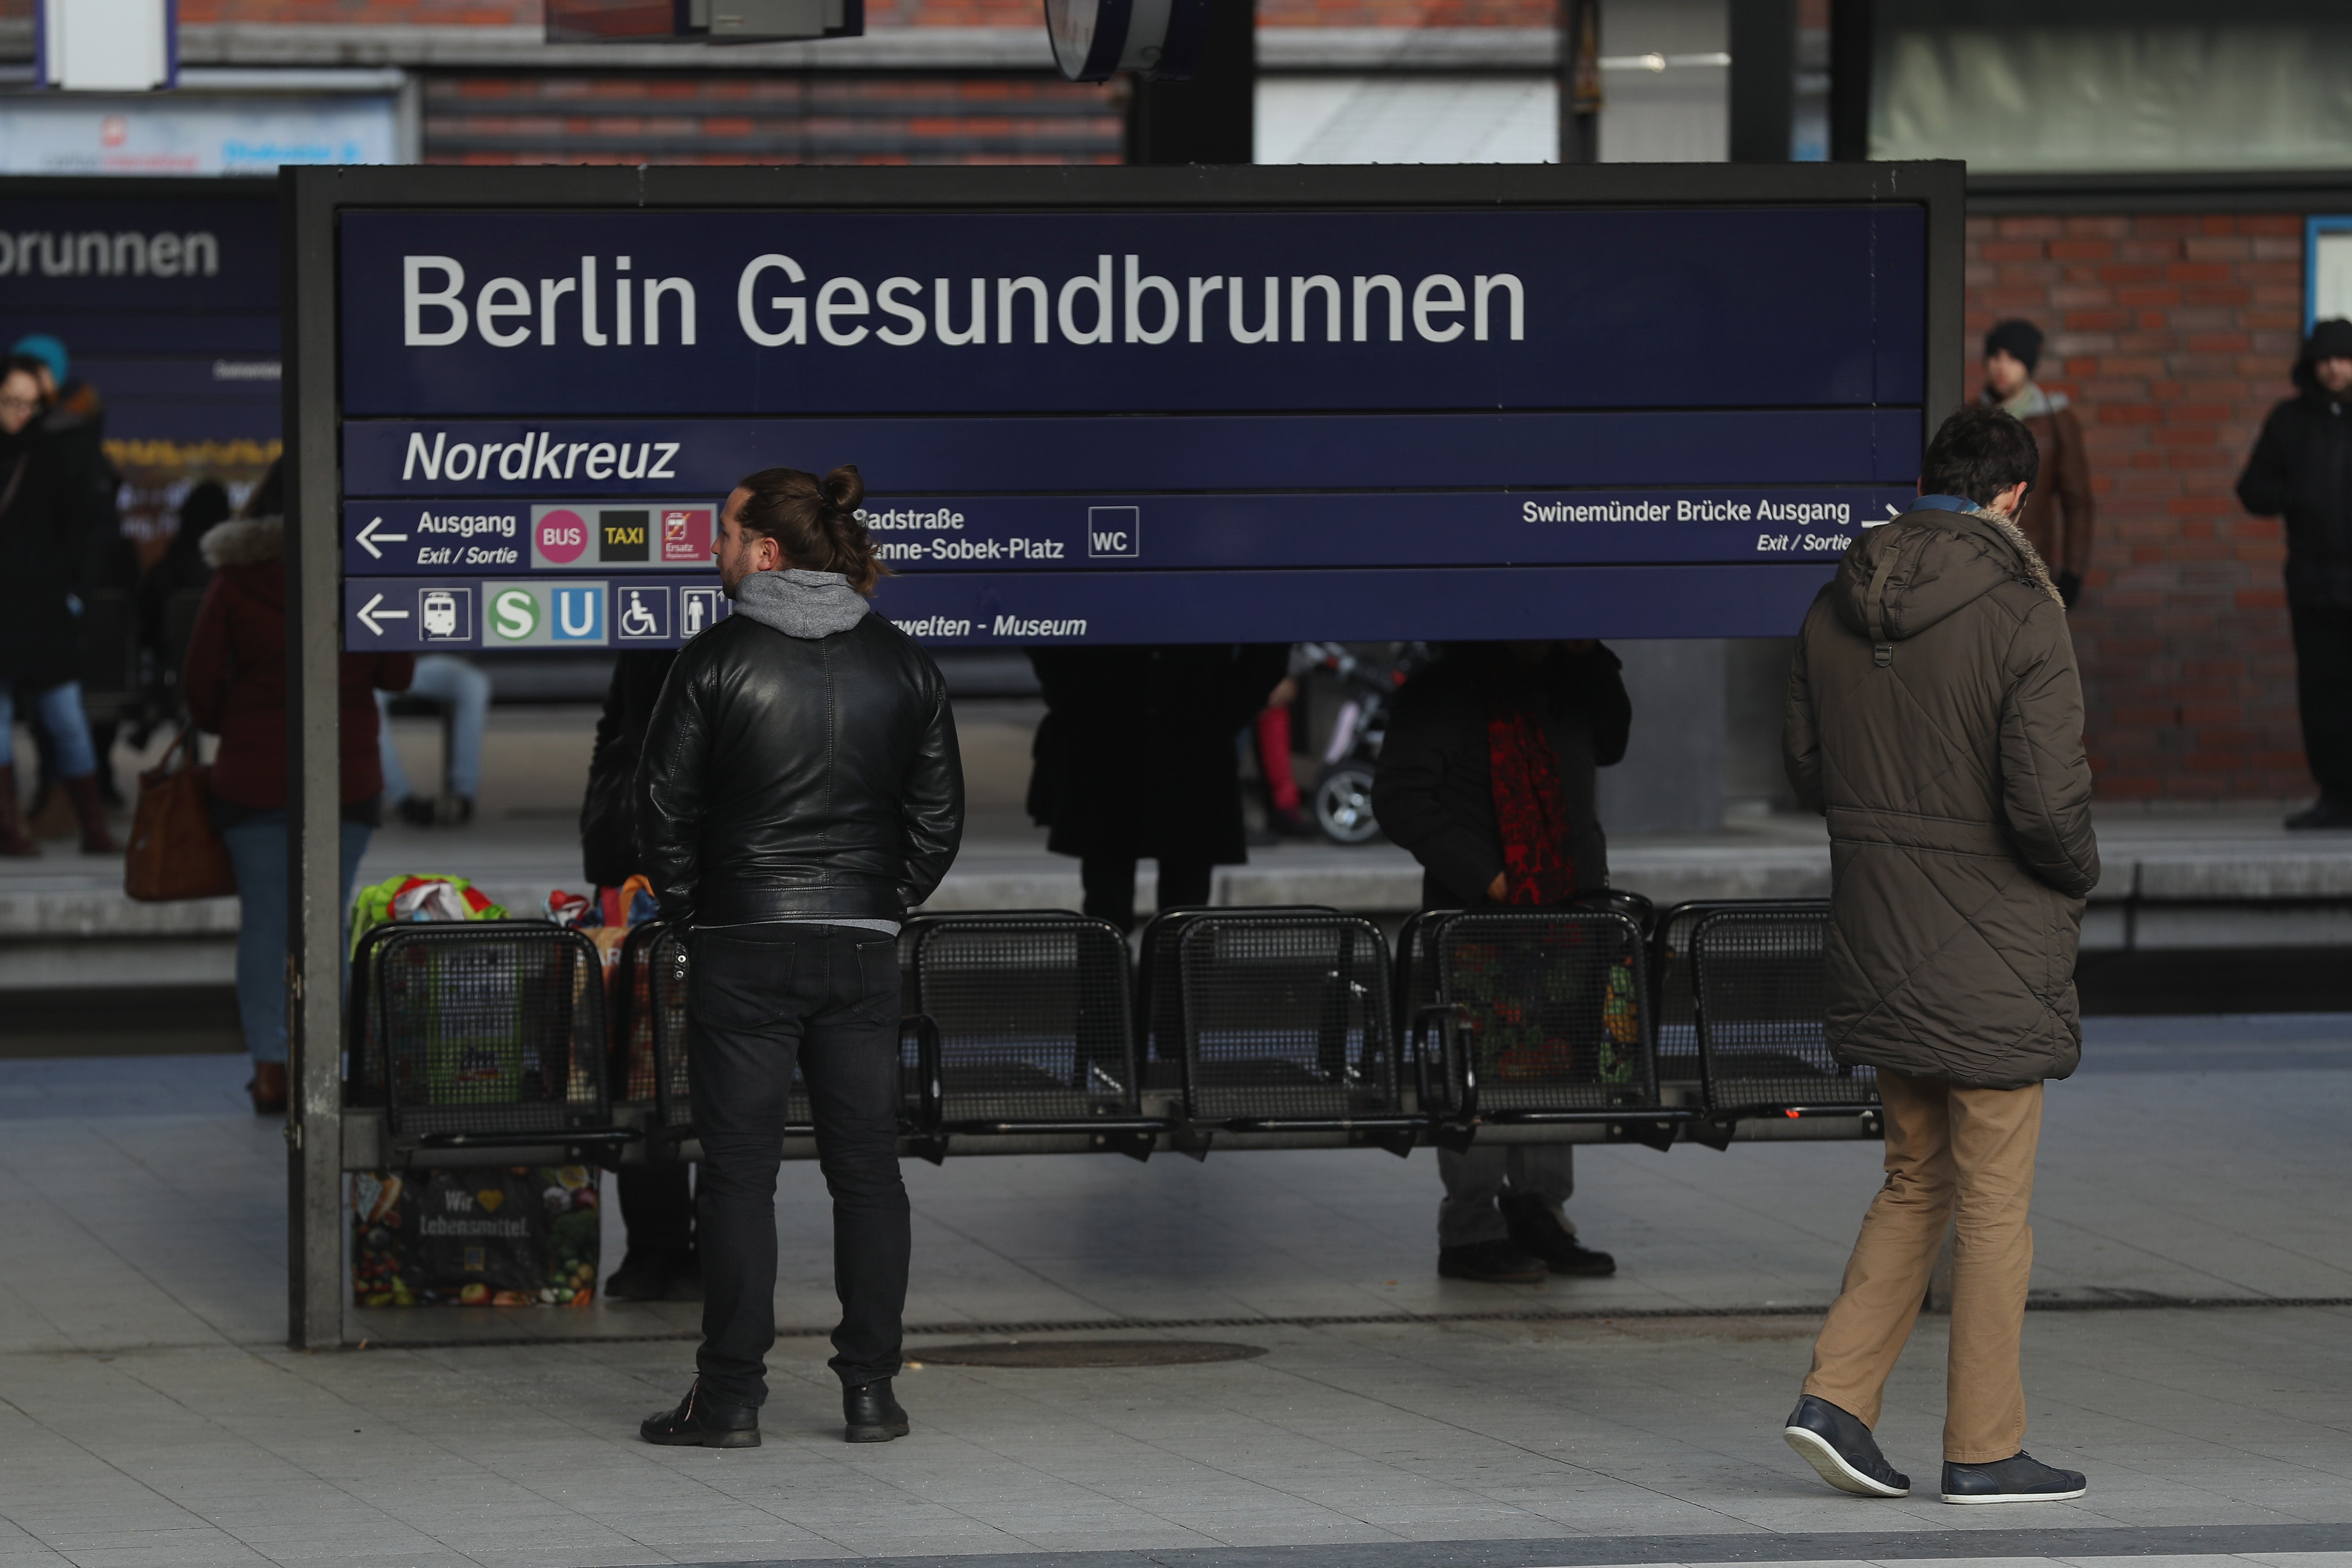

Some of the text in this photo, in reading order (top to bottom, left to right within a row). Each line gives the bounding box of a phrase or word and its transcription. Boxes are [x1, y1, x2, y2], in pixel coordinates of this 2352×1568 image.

[403, 253, 1524, 348] Berlin Gesundbrunnen
[402, 431, 680, 481] Nordkreuz
[1522, 499, 1850, 525] Swinemünder Brücke Ausgang
[416, 510, 516, 538] Ausgang
[604, 527, 644, 544] TAXI
[543, 528, 581, 546] BUS
[666, 543, 694, 551] Ersatz
[1093, 531, 1127, 551] WC
[1756, 533, 1852, 551] Exit / Sortie
[417, 546, 518, 565] Exit / Sortie
[865, 537, 1065, 561] anne-Sobek-Platz
[496, 591, 594, 638] S U
[992, 614, 1087, 637] Museum
[445, 1189, 473, 1213] Wir
